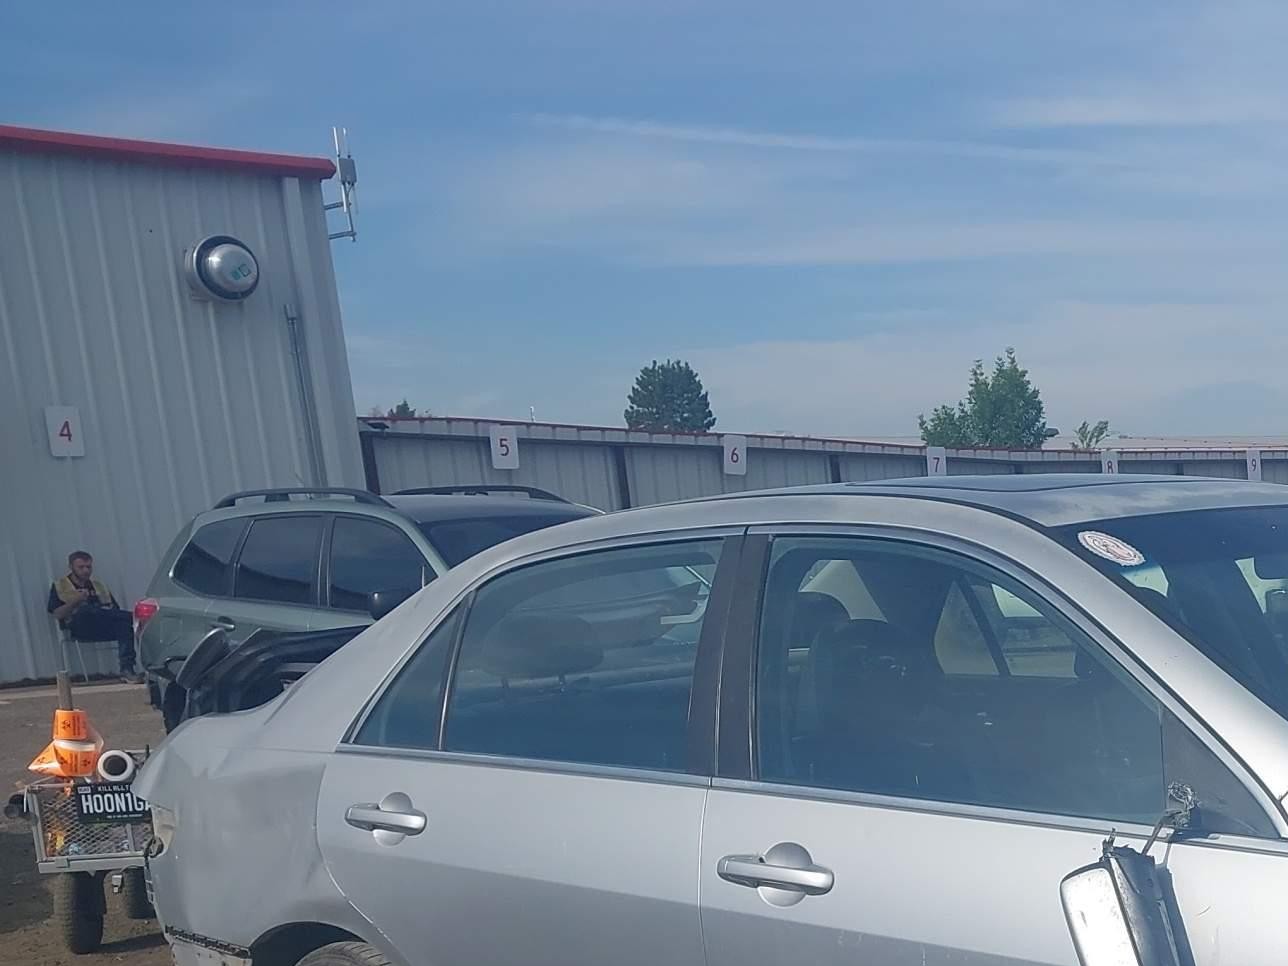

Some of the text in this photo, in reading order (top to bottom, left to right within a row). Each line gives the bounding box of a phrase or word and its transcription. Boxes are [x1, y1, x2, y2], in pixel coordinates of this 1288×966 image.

[59, 420, 72, 441] 4
[499, 438, 510, 457] 5
[730, 447, 740, 464] 6
[933, 457, 940, 473] 7
[1106, 460, 1114, 474] 8
[1251, 459, 1256, 472] 9
